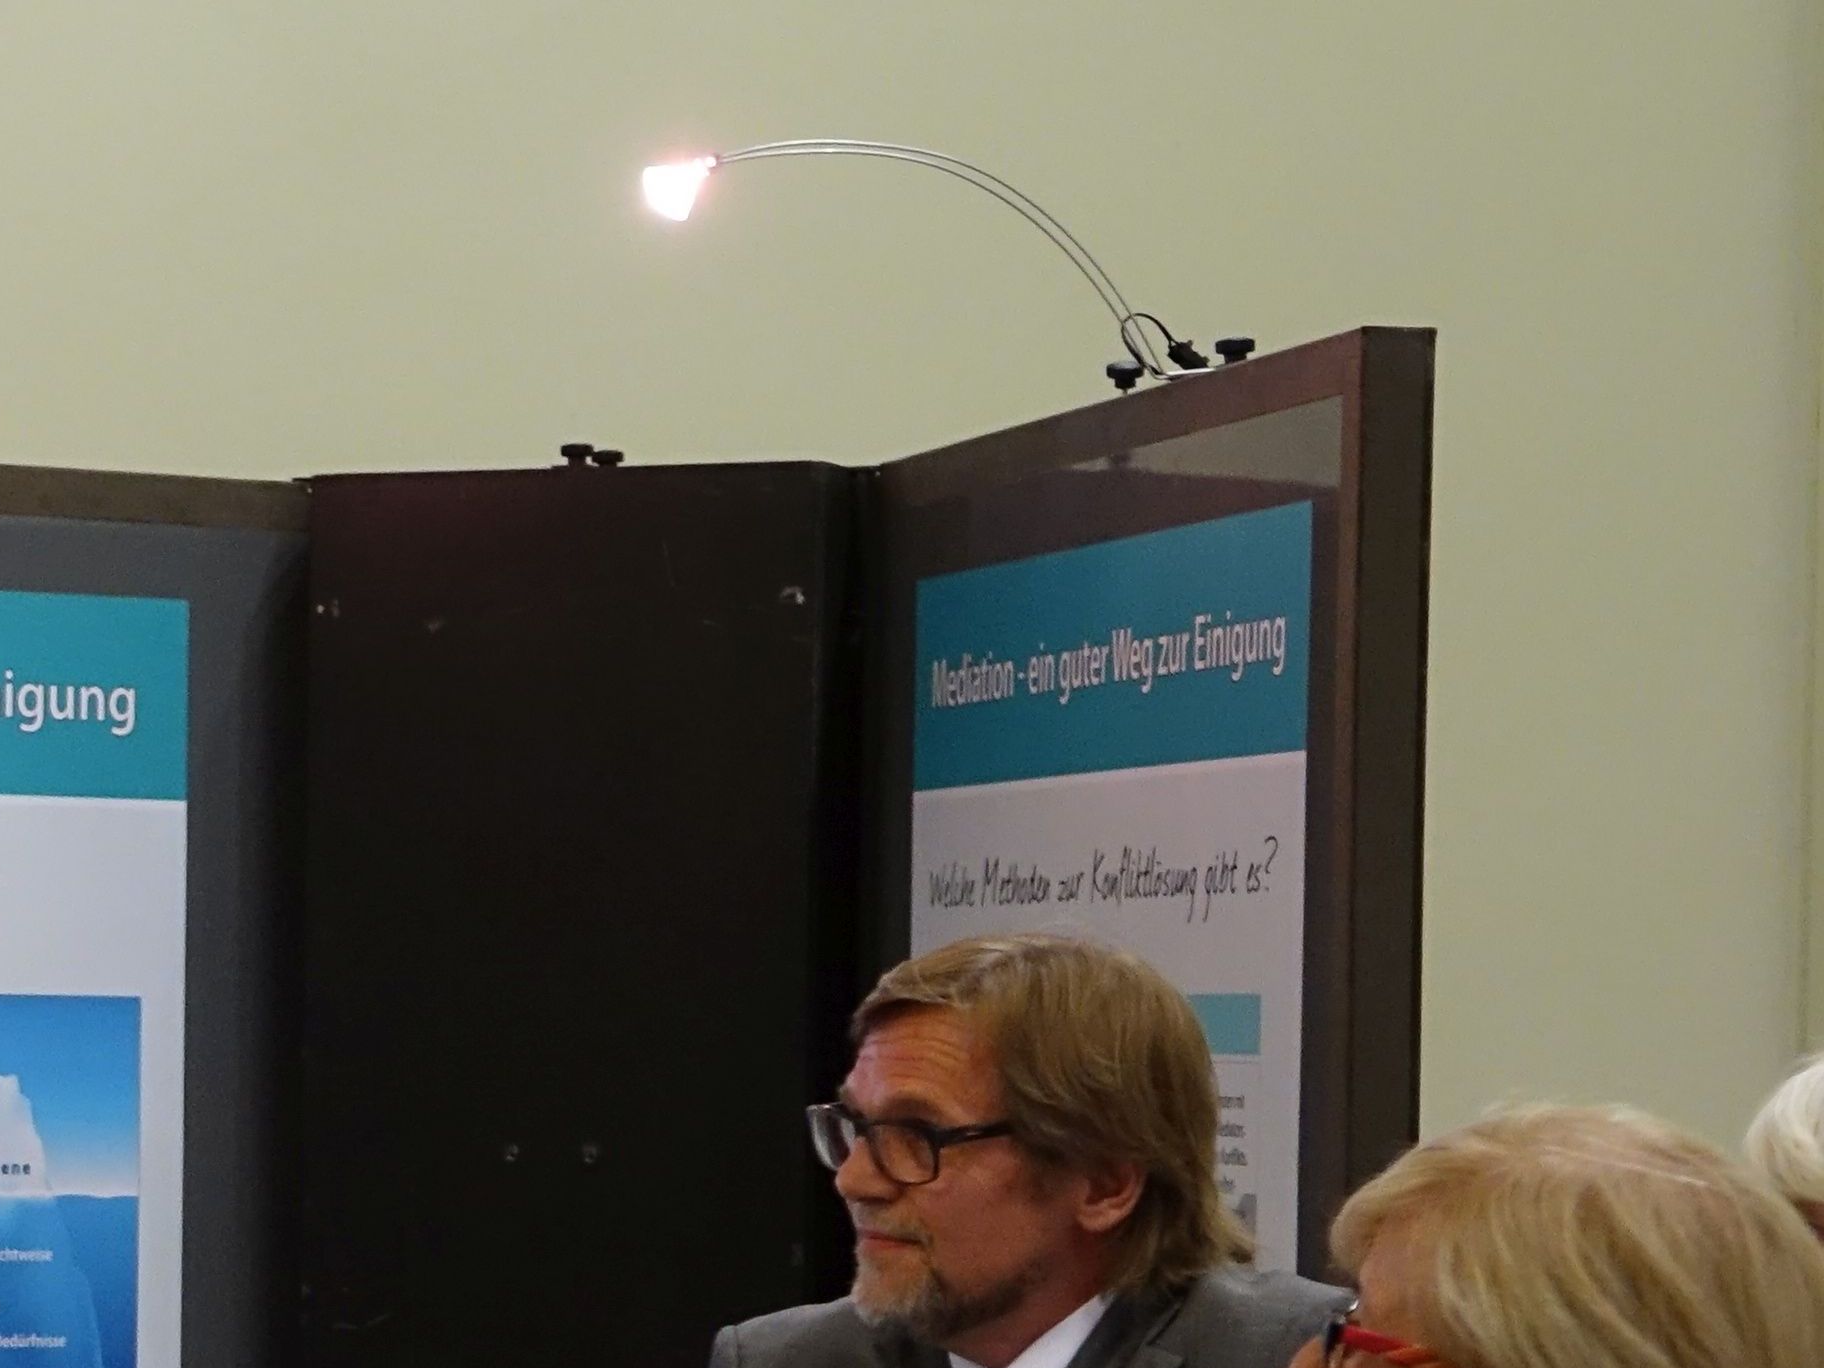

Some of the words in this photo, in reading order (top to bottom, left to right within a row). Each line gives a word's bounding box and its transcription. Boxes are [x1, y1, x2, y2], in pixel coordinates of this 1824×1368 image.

[932, 651, 1014, 708] Mediation
[1028, 642, 1055, 695] ein
[1059, 641, 1109, 705] guter
[1112, 628, 1153, 694] Weg
[1157, 632, 1190, 675] zur
[1194, 610, 1286, 682] Einigung
[930, 862, 975, 909] Welche
[980, 857, 1050, 907] Methoden
[1057, 871, 1084, 902] zur
[1090, 846, 1197, 924] Konfliktlösung
[1202, 850, 1238, 923] gibt
[1247, 835, 1279, 894] es?
